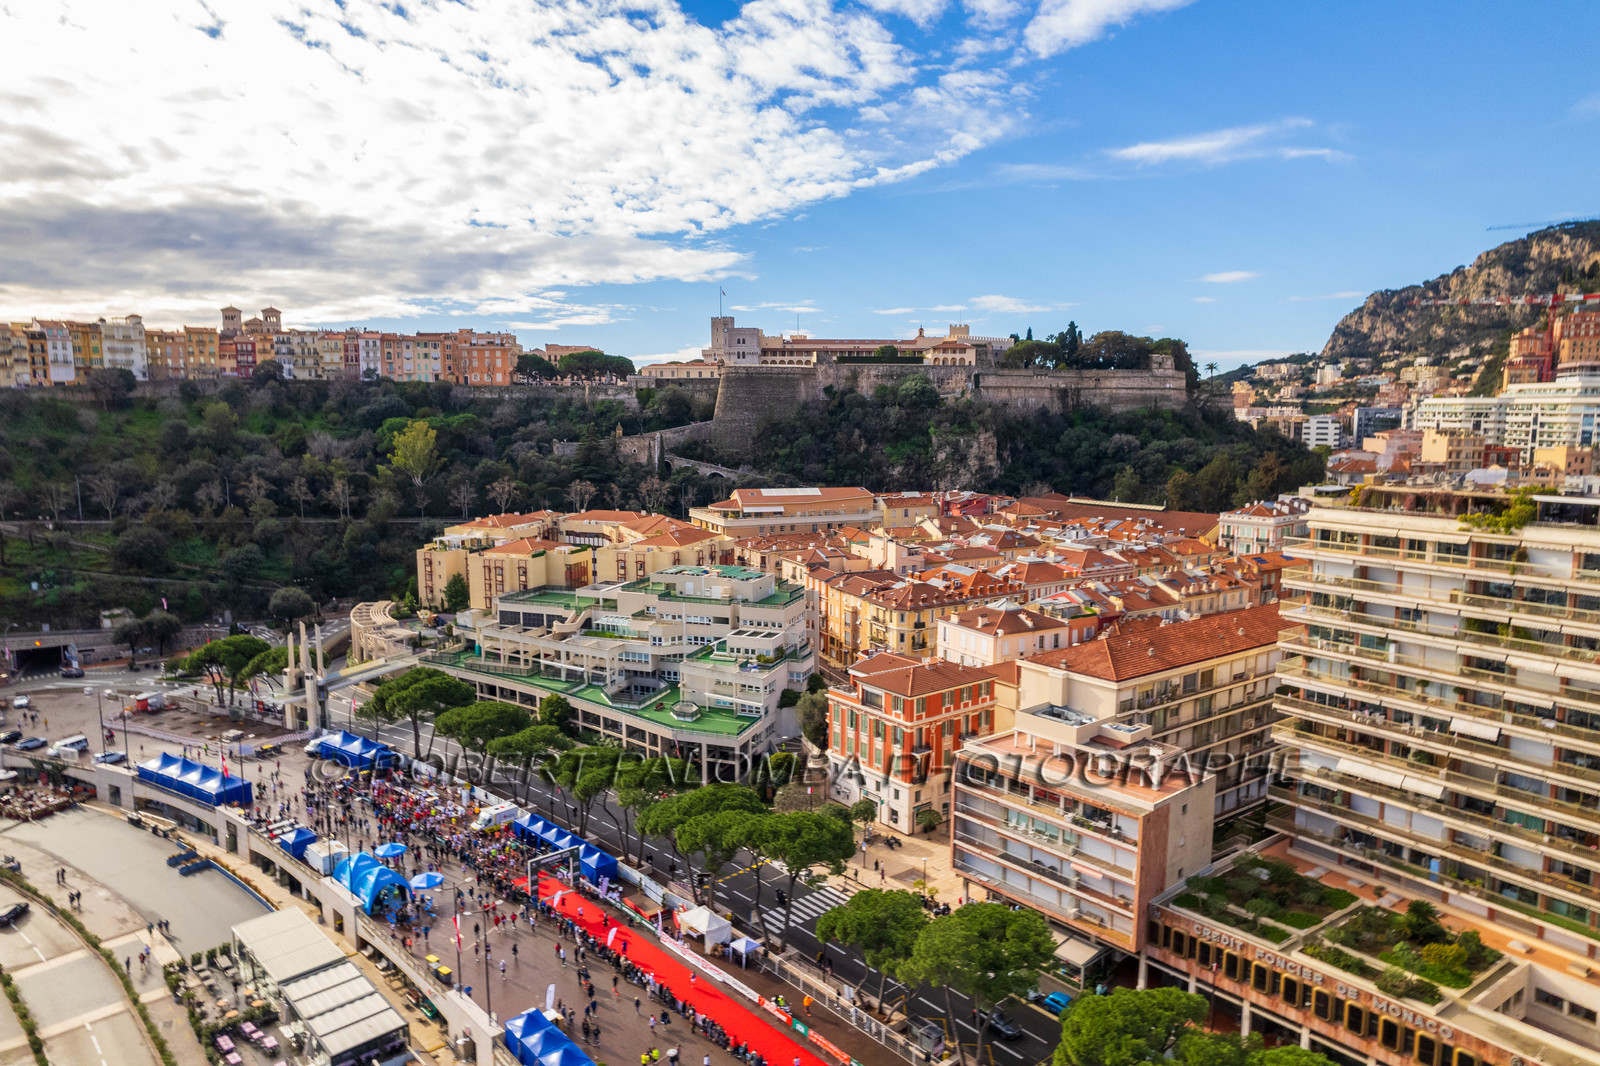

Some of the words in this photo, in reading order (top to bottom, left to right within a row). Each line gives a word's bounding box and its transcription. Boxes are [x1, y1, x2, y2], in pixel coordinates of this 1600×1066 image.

[1255, 949, 1324, 985] FONCIER
[1337, 983, 1359, 1000] DE
[1372, 996, 1453, 1039] MONACO
